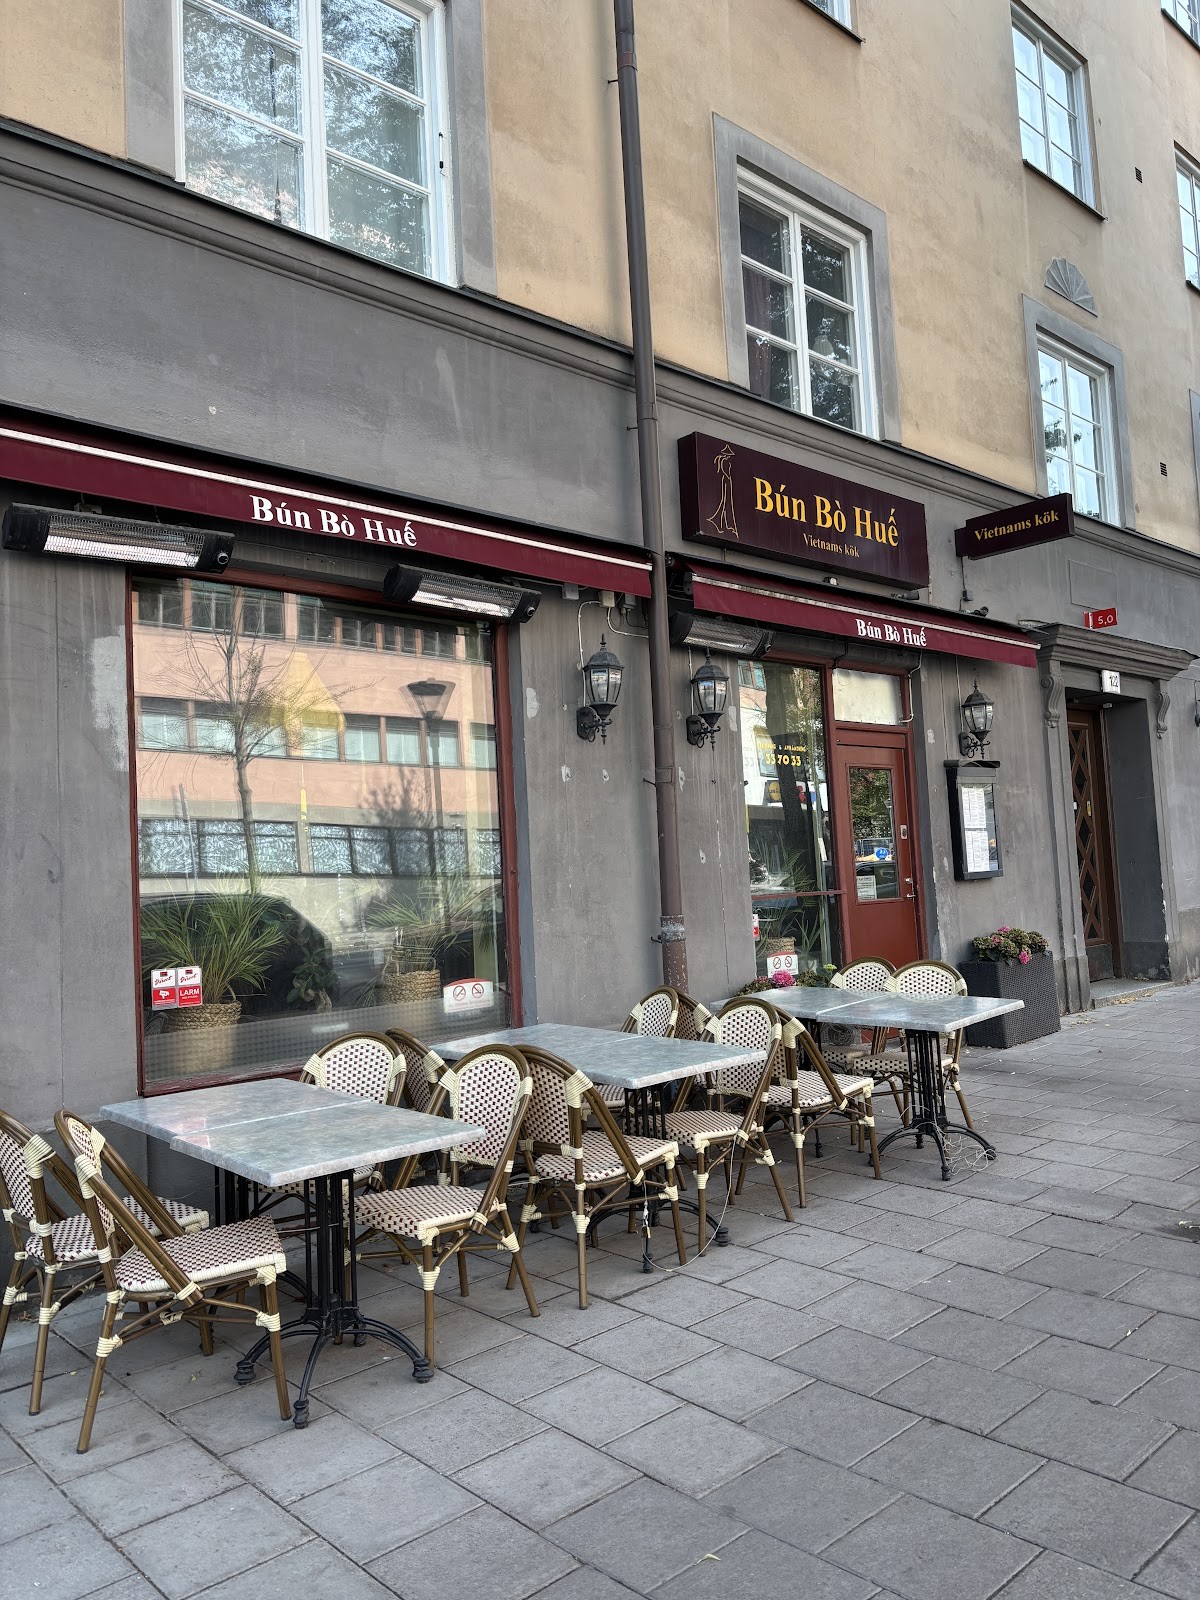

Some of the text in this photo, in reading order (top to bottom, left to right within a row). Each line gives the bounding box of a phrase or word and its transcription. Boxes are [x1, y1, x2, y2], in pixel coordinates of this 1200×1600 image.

[249, 494, 418, 547] Bún Bò Huế
[753, 476, 899, 547] Bún Bò Huế
[974, 510, 1060, 541] Vietnams kök
[803, 532, 860, 558] Vietnams kök
[855, 618, 927, 647] Bún Bò Huế
[1097, 614, 1114, 625] 5,0
[777, 754, 790, 766] 70
[791, 755, 801, 767] 33
[180, 988, 200, 997] LARM
